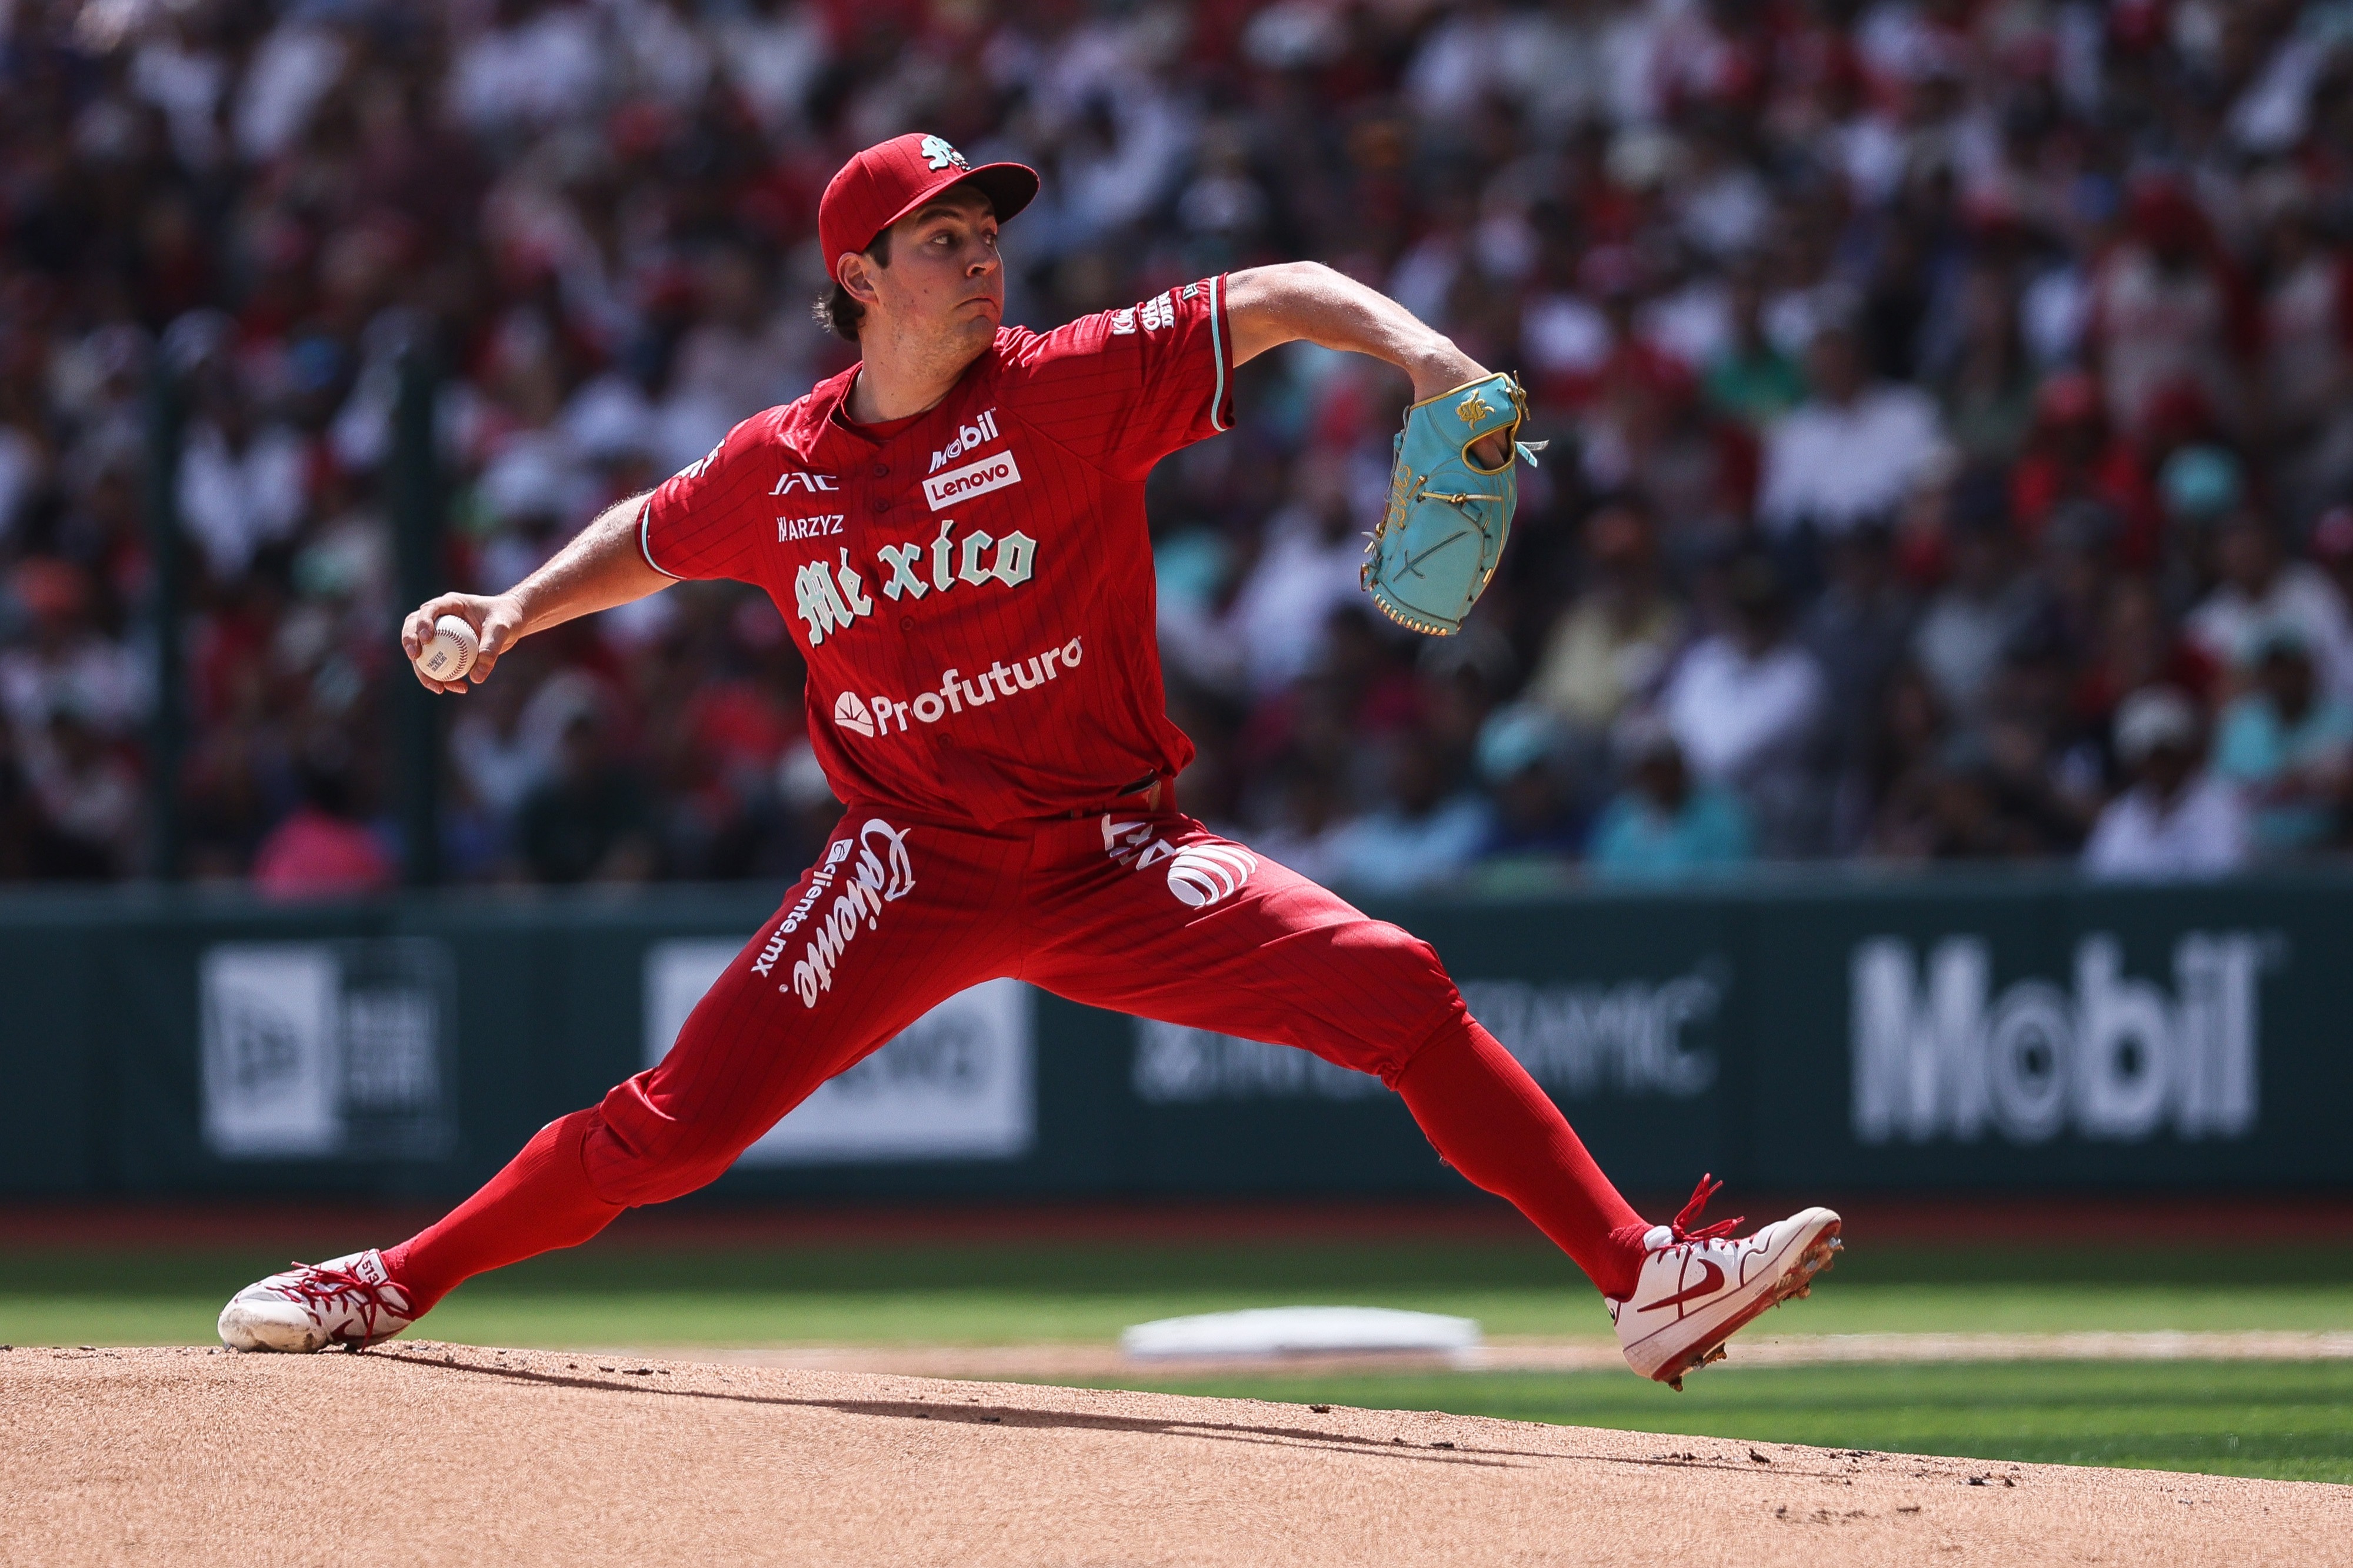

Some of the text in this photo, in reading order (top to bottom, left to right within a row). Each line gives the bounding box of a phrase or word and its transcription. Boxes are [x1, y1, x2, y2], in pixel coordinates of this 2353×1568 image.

[928, 411, 999, 474] Mobil
[931, 463, 1009, 501] Lenovo
[871, 638, 1082, 737] Profuturo
[1847, 931, 2258, 1144] Mobil
[362, 1260, 380, 1283] 513
